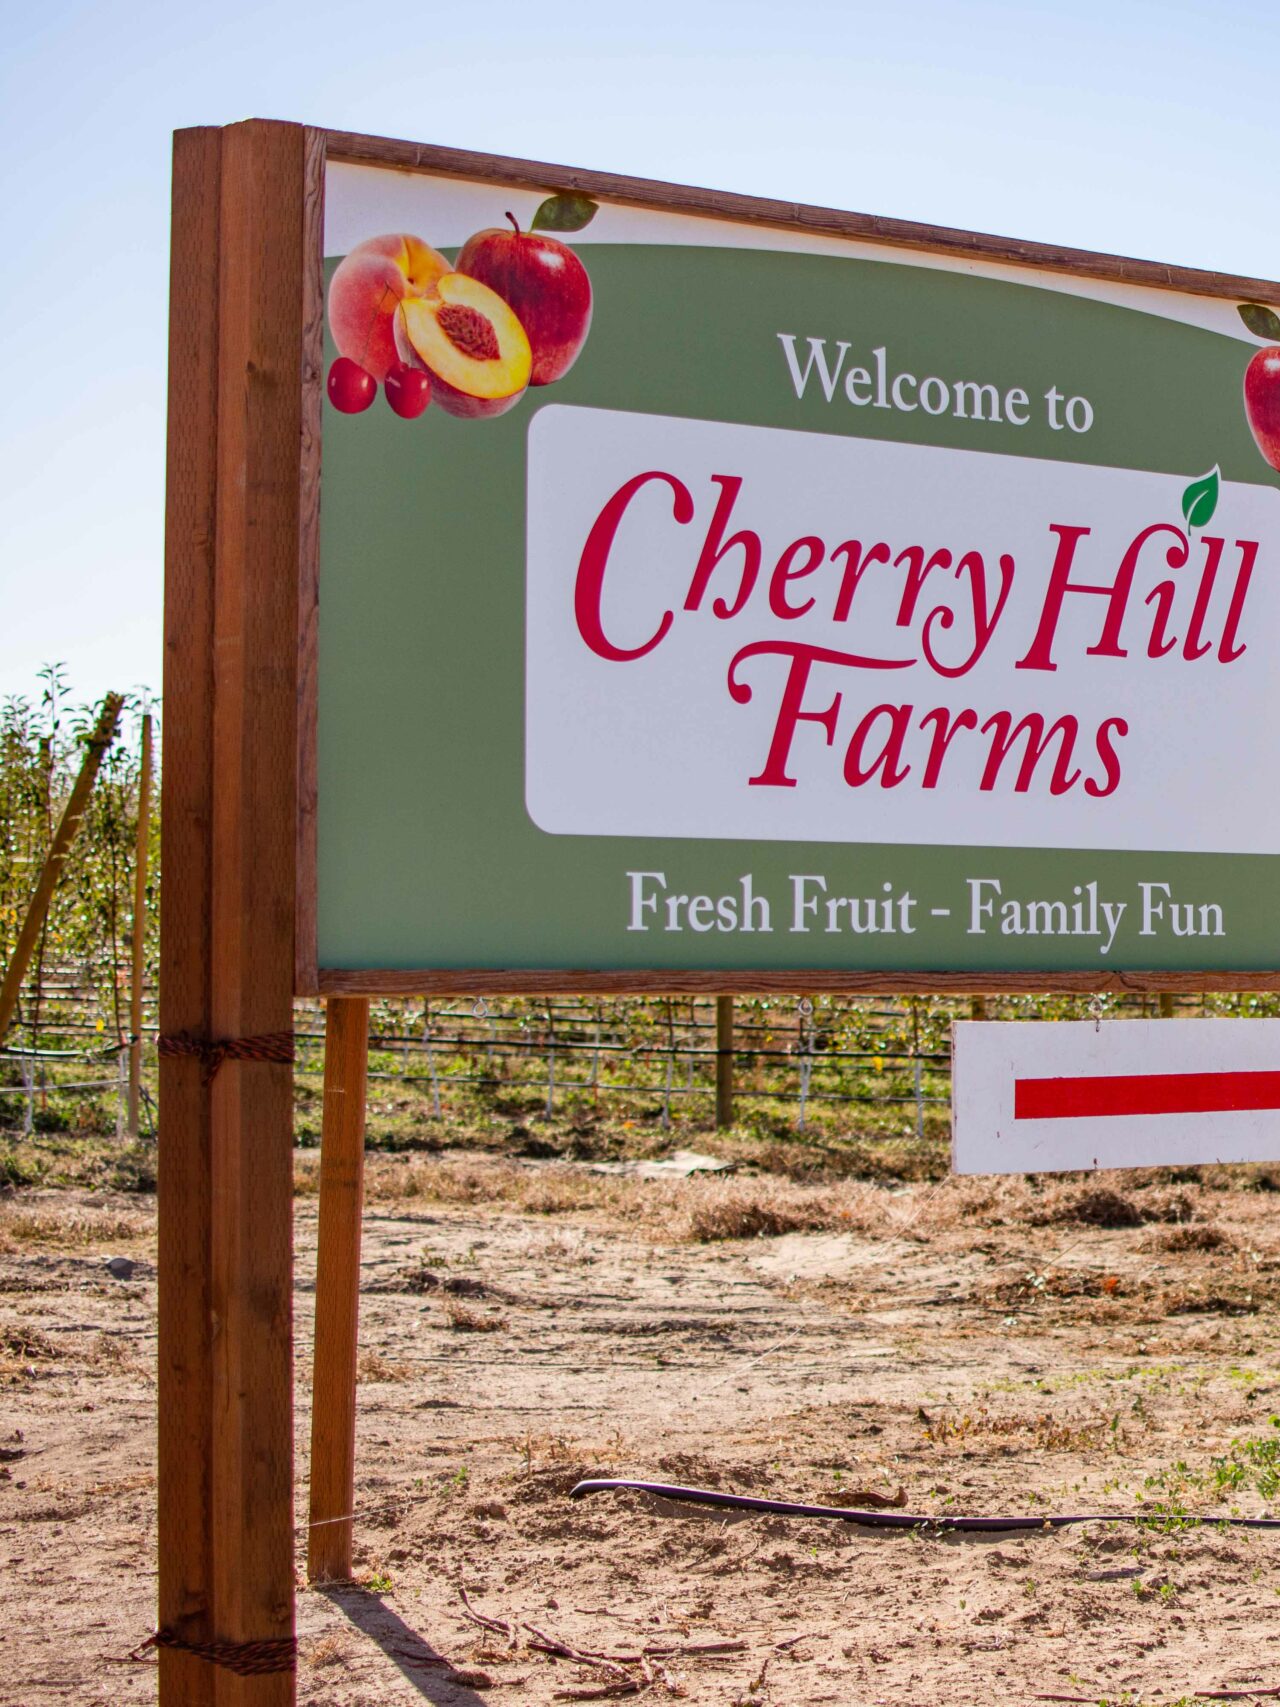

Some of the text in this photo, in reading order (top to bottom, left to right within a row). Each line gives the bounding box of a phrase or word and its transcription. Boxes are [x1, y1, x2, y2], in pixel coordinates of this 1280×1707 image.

[775, 332, 1095, 433] Welcome to
[573, 470, 1260, 679] Cherry Hill
[726, 640, 1130, 798] Farms
[625, 870, 774, 932] Fresh
[788, 873, 918, 934] Fruit
[965, 878, 1128, 954] Family
[1137, 882, 1227, 936] Fun
